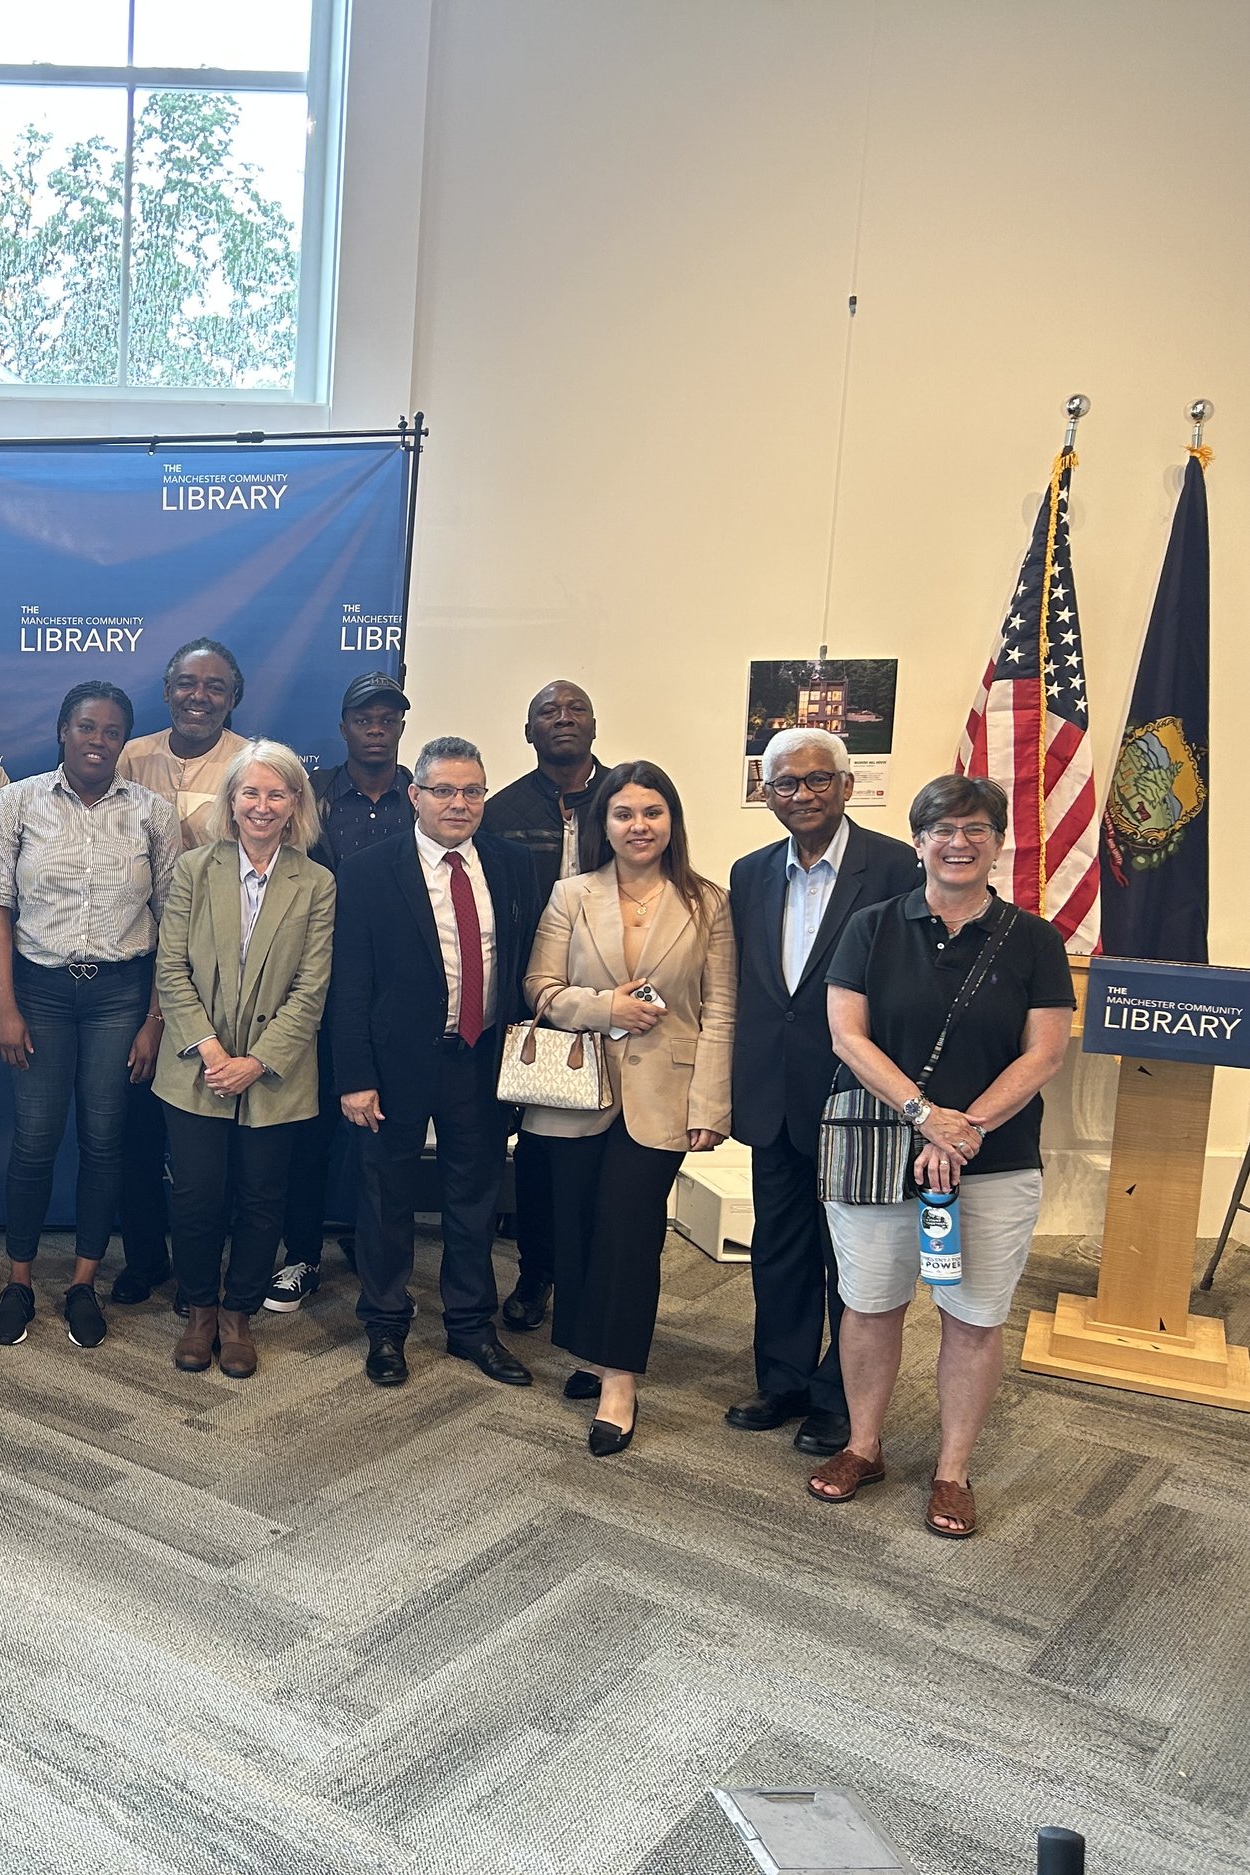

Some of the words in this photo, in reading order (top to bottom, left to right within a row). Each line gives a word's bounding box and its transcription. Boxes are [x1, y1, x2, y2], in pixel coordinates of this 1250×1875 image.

[163, 464, 182, 472] THE
[163, 475, 227, 483] MANCHESTER
[229, 474, 288, 482] COMMUNITY
[162, 485, 288, 510] LIBRARY
[21, 605, 39, 613] THE
[342, 604, 361, 612] THE
[85, 617, 144, 625] COMMUNITY
[20, 628, 144, 652] LIBRARY
[1107, 986, 1128, 995] THE
[1106, 996, 1175, 1010] MANCHESTER
[1177, 1002, 1243, 1016] COMMUNITY
[1104, 1006, 1242, 1040] LIBRARY
